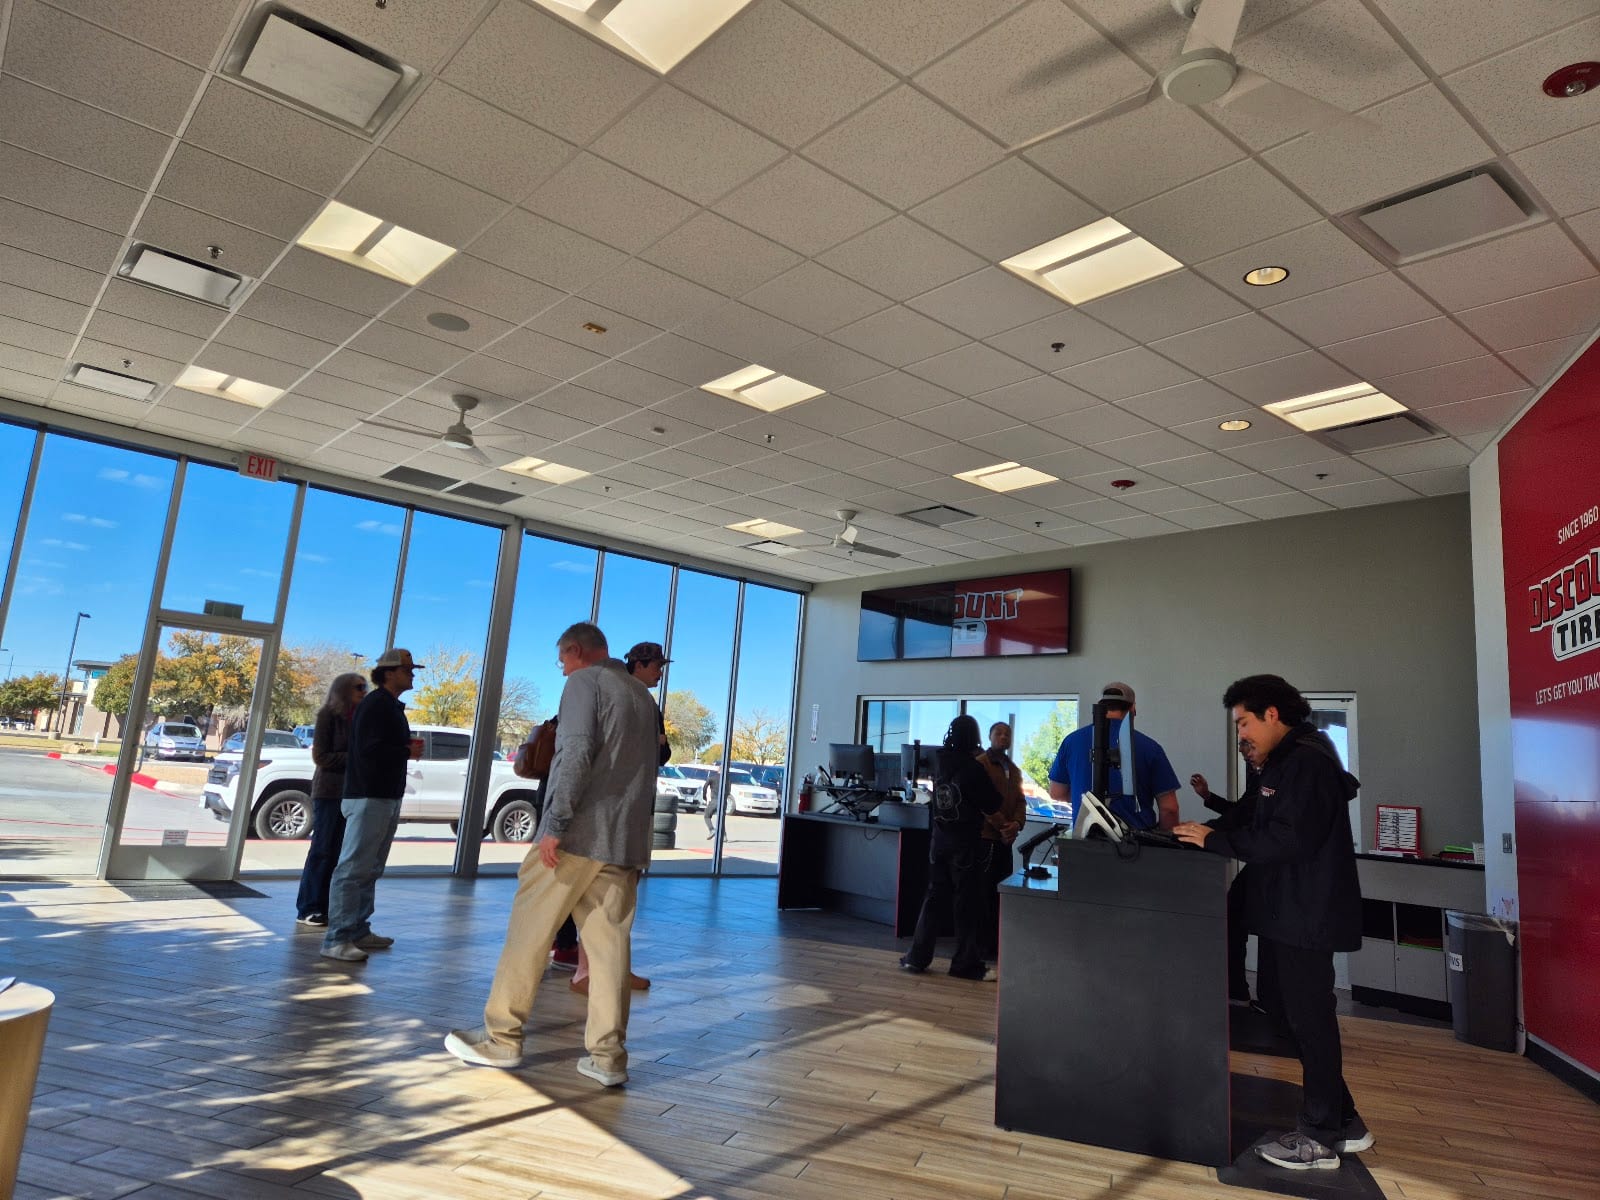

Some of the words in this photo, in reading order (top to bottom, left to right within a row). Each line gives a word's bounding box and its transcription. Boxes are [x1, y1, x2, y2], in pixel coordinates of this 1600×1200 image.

[247, 455, 277, 478] EXIT
[1558, 518, 1580, 545] SINCE
[1580, 505, 1599, 530] 1960
[1553, 682, 1567, 700] GET
[1566, 677, 1583, 696] YOU
[1583, 671, 1600, 692] TAK
